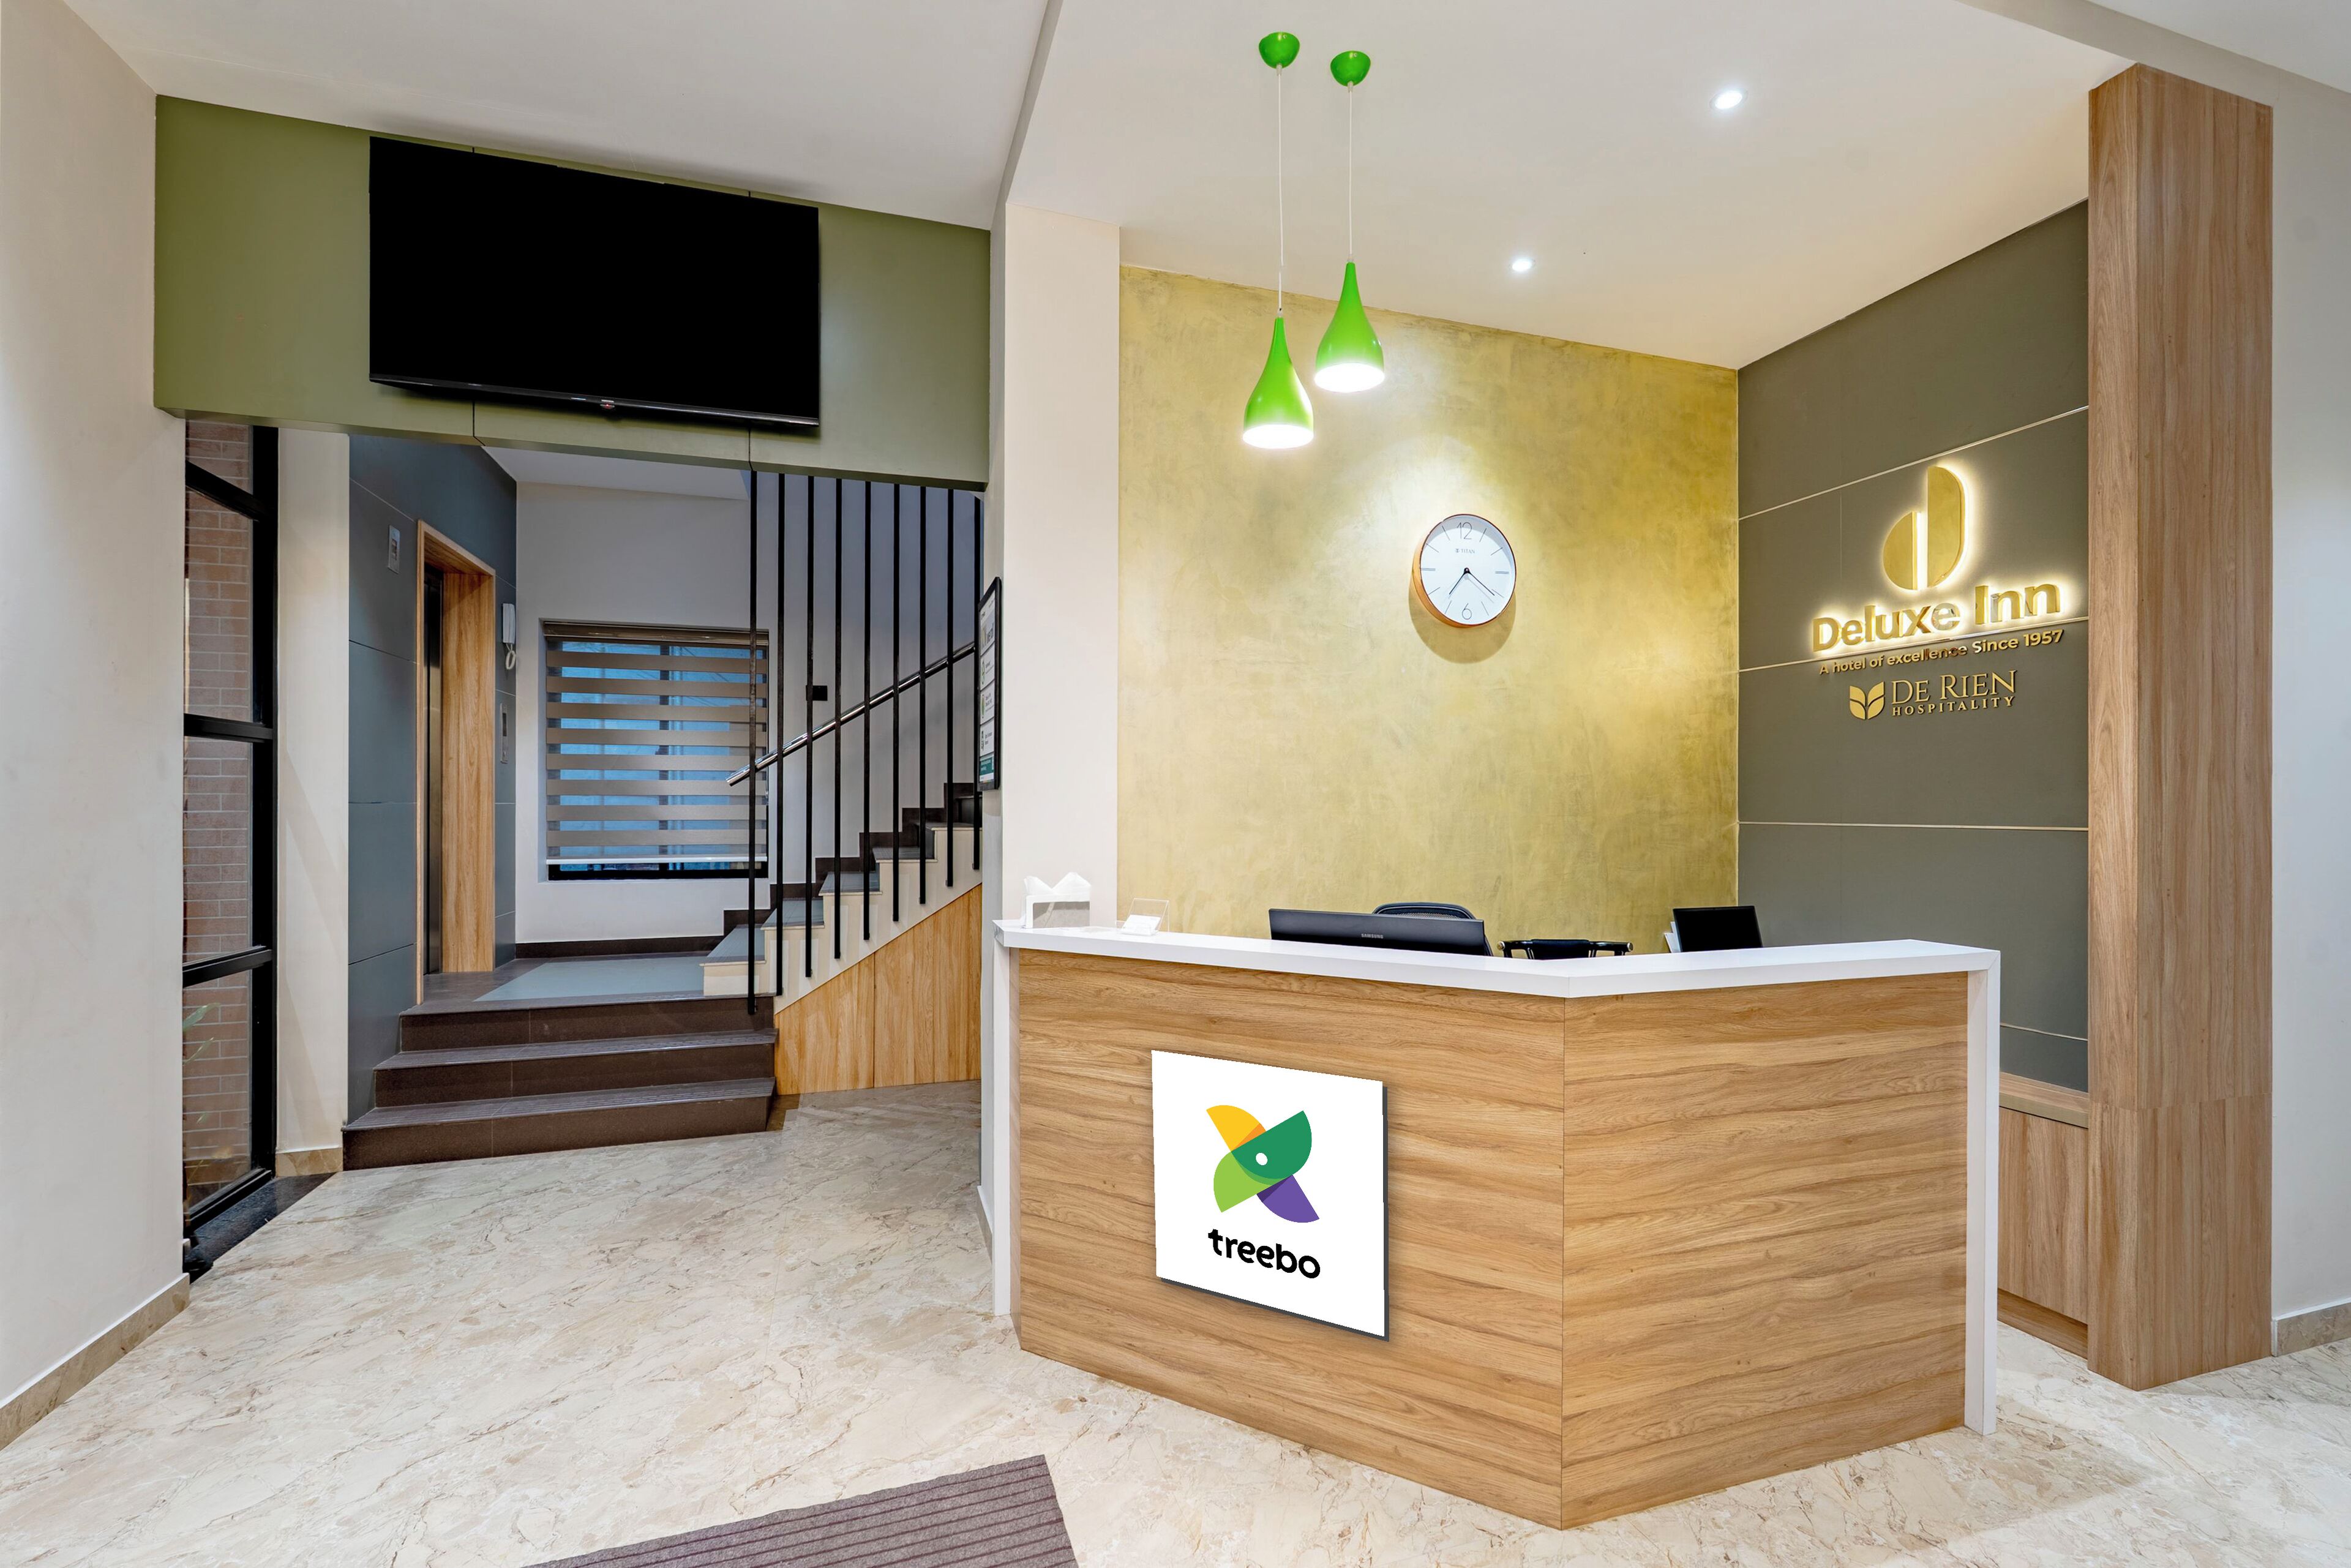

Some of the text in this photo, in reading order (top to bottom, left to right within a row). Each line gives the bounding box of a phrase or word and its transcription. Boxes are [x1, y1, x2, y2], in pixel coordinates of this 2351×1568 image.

[1457, 522, 1472, 540] 12
[1461, 602, 1472, 620] 6
[1812, 583, 2061, 652] Deluxe Inn
[1819, 628, 2064, 675] A hotel of excellence Since 1957
[1891, 669, 2017, 705] DE RIEN
[1892, 696, 2015, 716] HOSPITALITY
[1207, 1228, 1321, 1280] treebo
